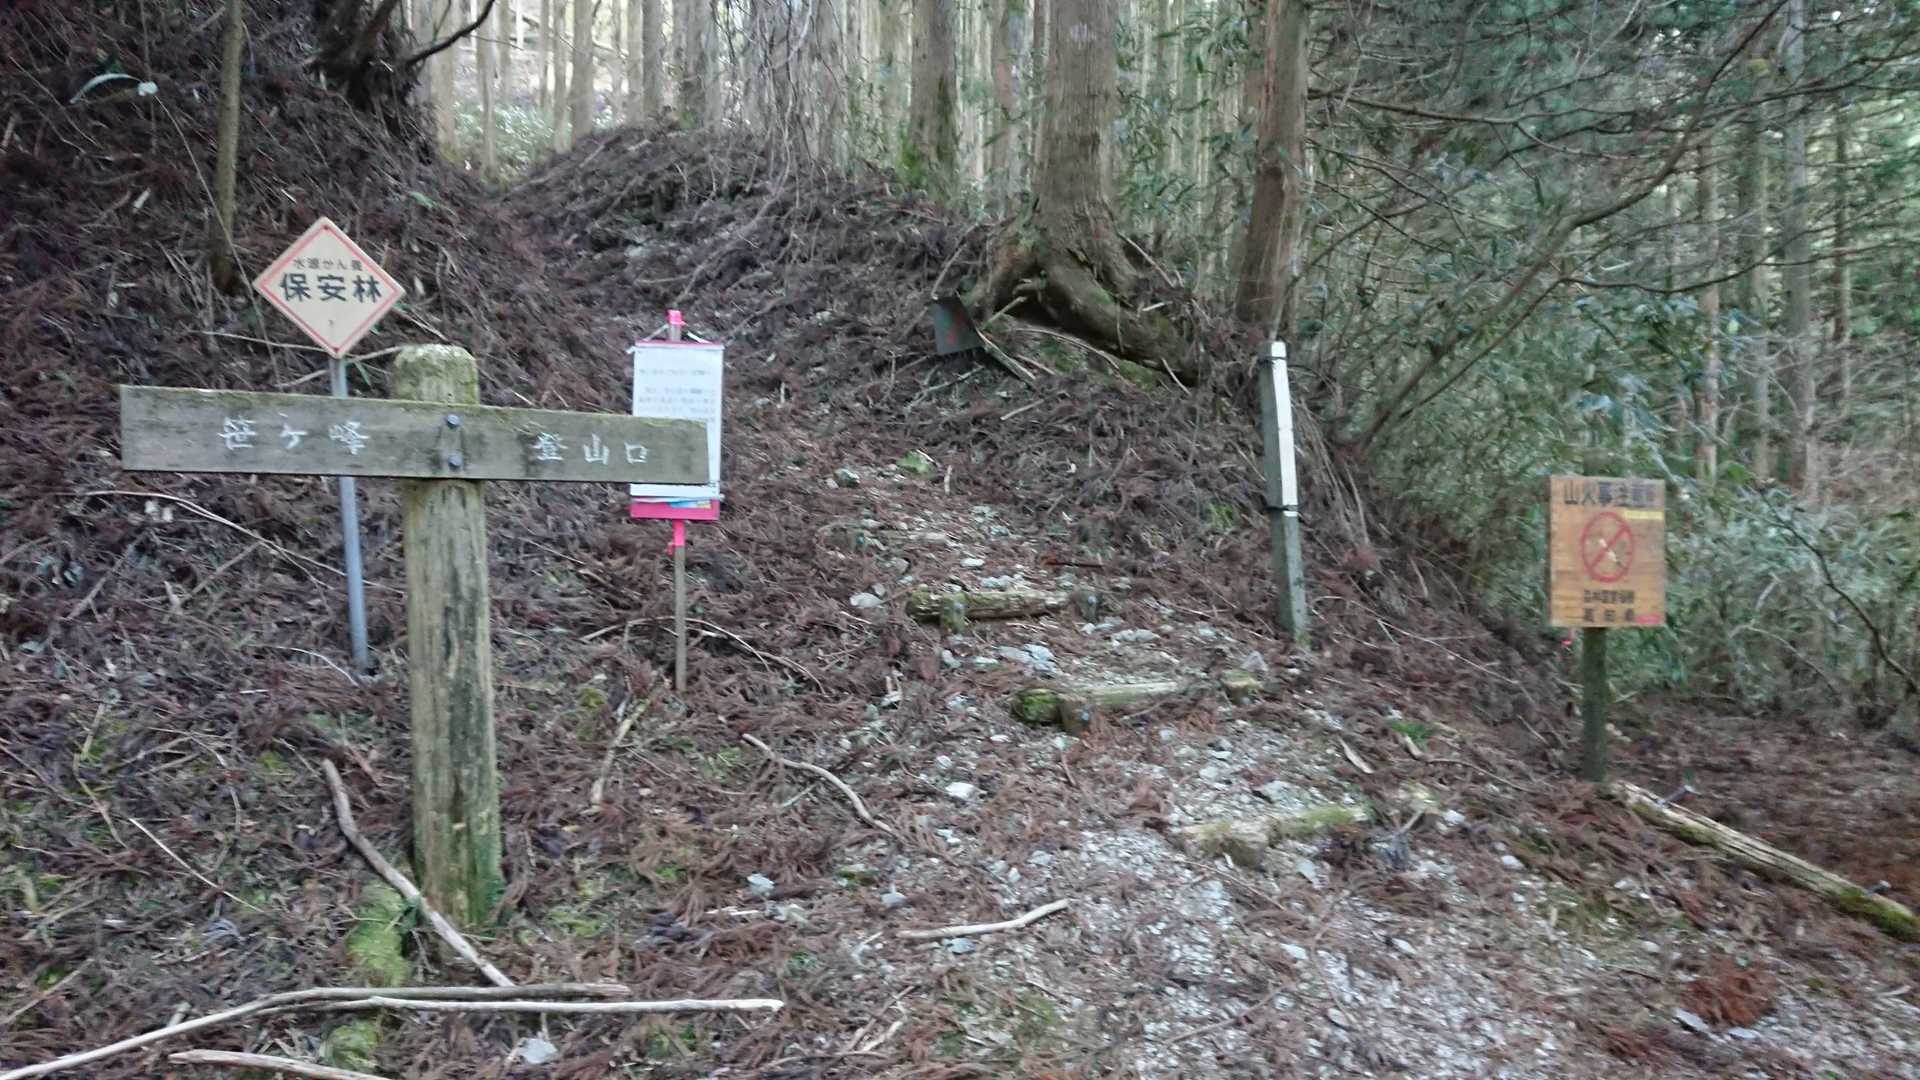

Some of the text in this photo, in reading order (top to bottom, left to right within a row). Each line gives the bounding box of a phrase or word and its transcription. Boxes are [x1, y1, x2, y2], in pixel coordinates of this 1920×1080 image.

[280, 272, 382, 303] 保安林
[533, 431, 649, 465] 登山口
